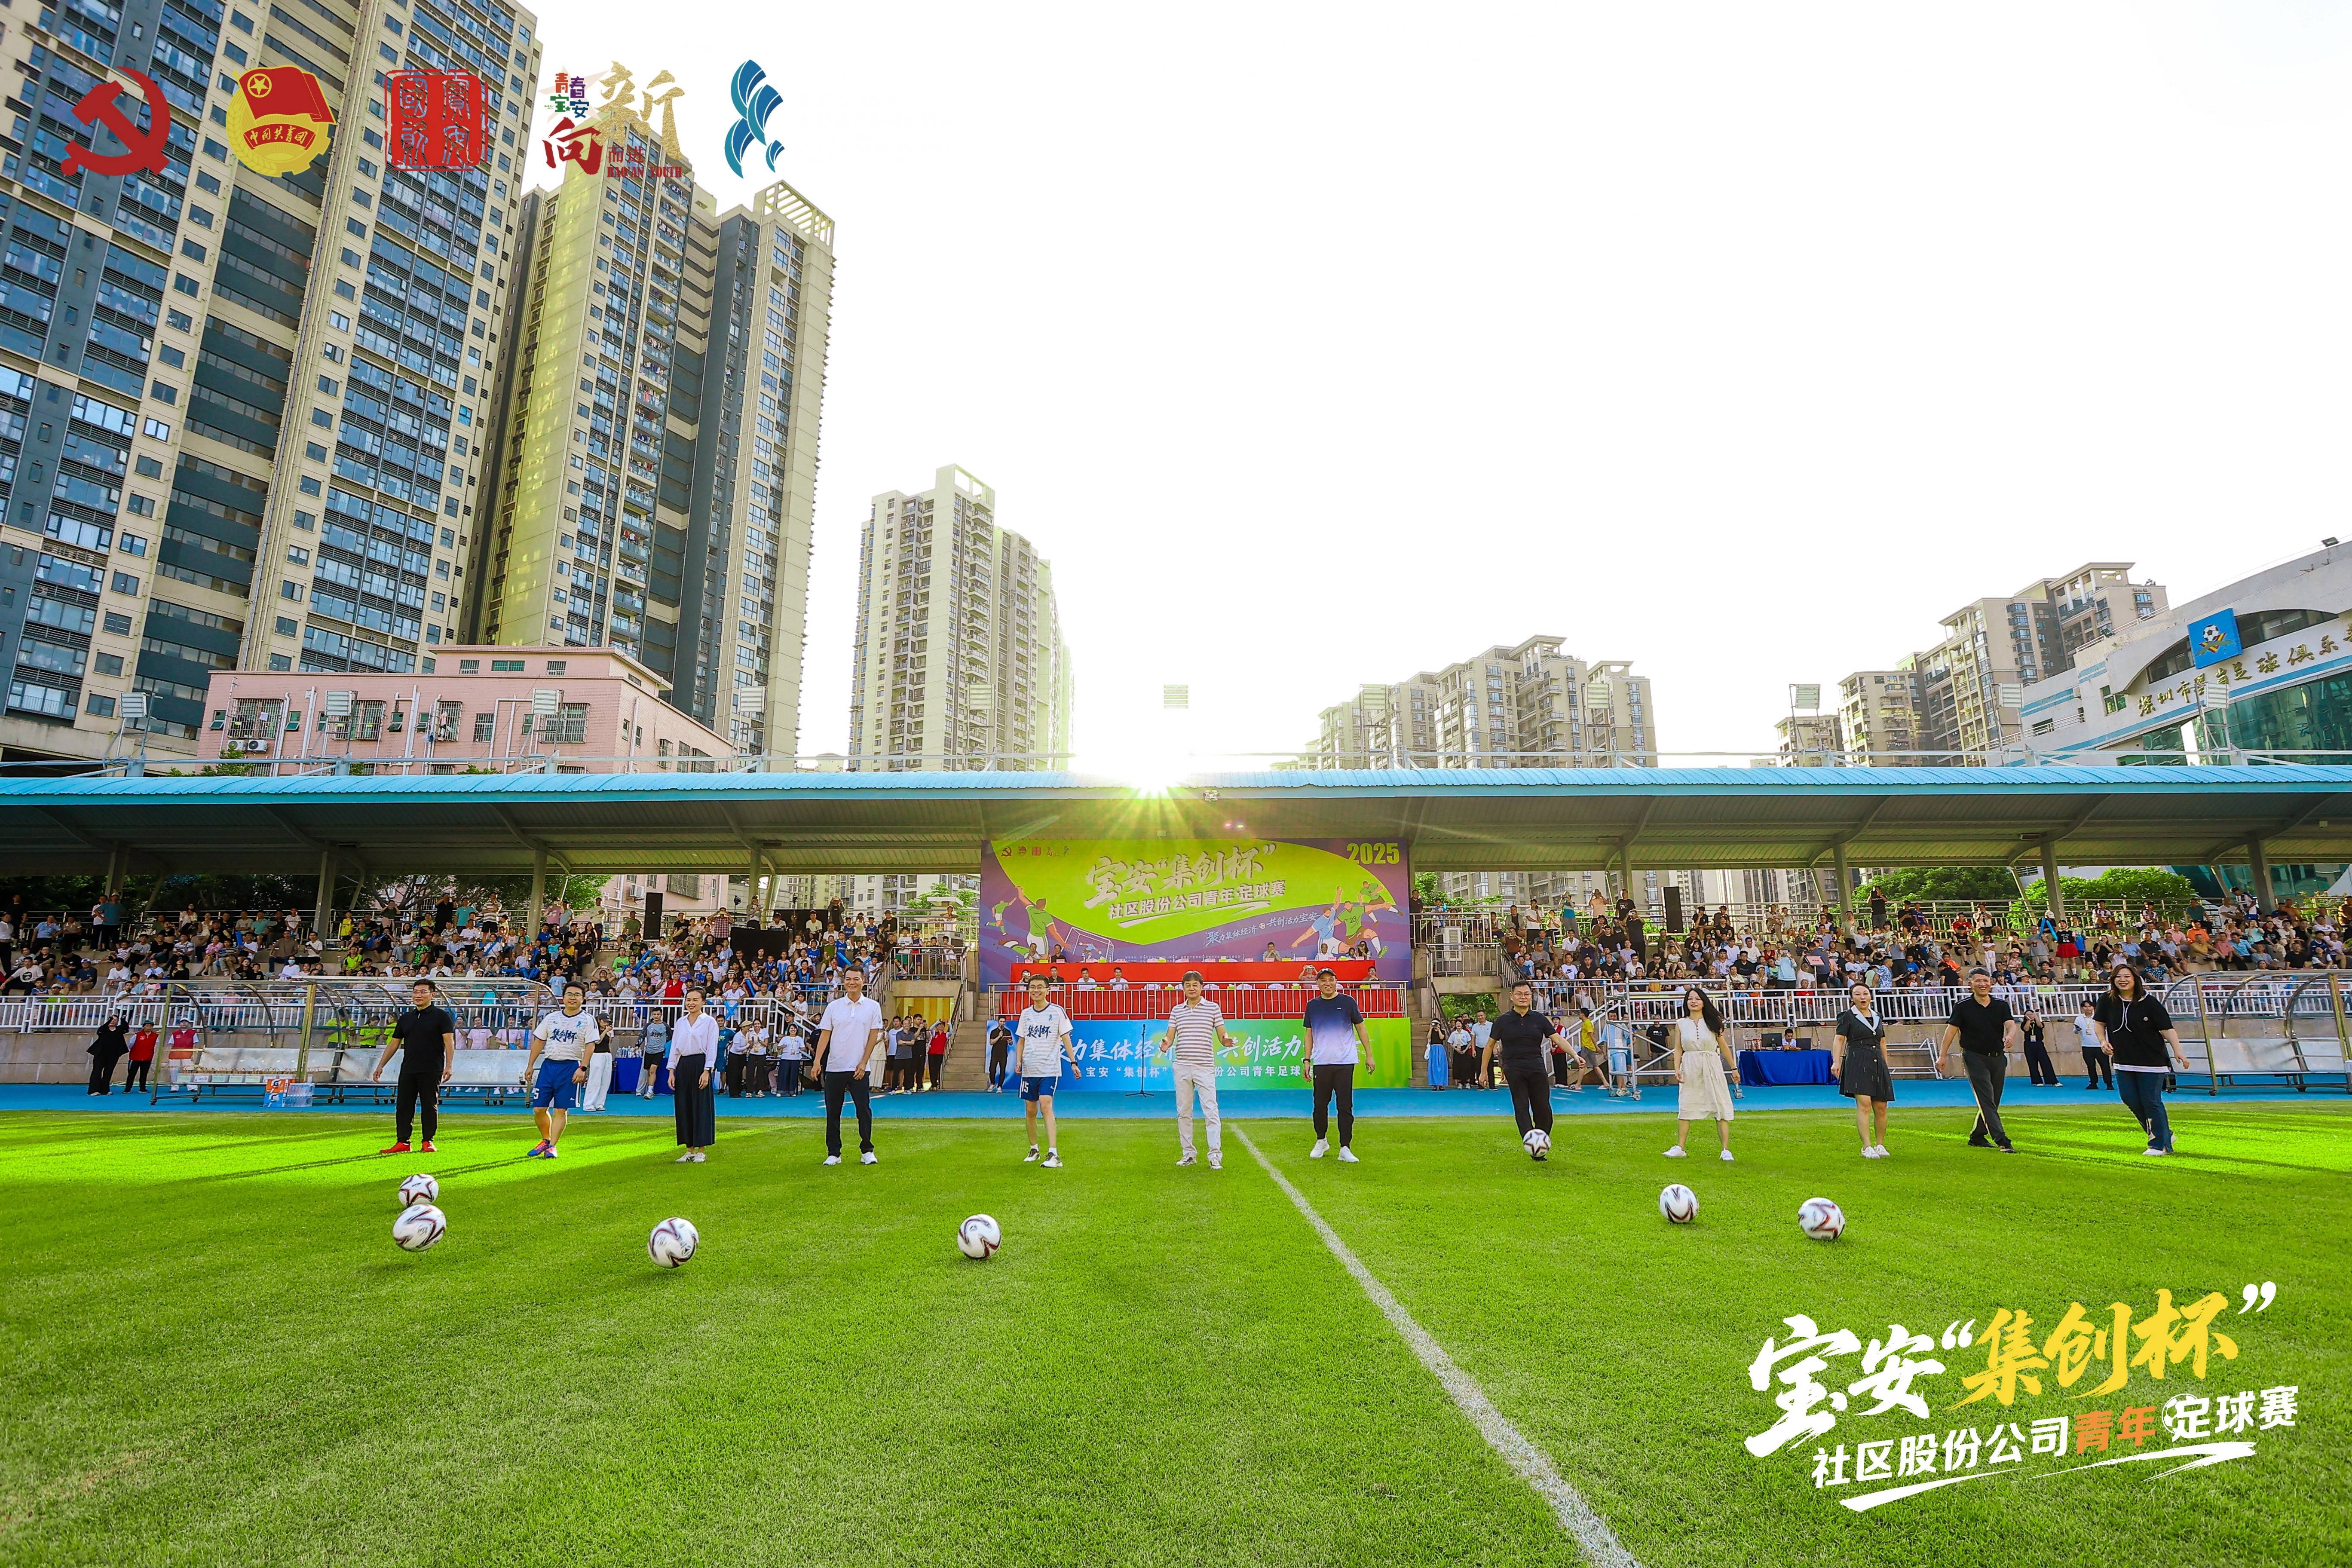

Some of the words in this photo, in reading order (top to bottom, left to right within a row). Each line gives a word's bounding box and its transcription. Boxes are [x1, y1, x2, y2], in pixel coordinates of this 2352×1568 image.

[1347, 843, 1400, 864] 2025
[1109, 880, 1286, 919] 社区股份公司青年足球赛
[1266, 911, 1321, 928] 共创活力宝安
[1205, 925, 1258, 947] 聚力集体经济
[549, 1028, 577, 1044] 集创杯
[1026, 1025, 1052, 1039] 集创杯
[1217, 1035, 1314, 1063] 共创活力
[1215, 1066, 1313, 1077] 份公司青年足球
[1021, 1081, 1029, 1093] 15
